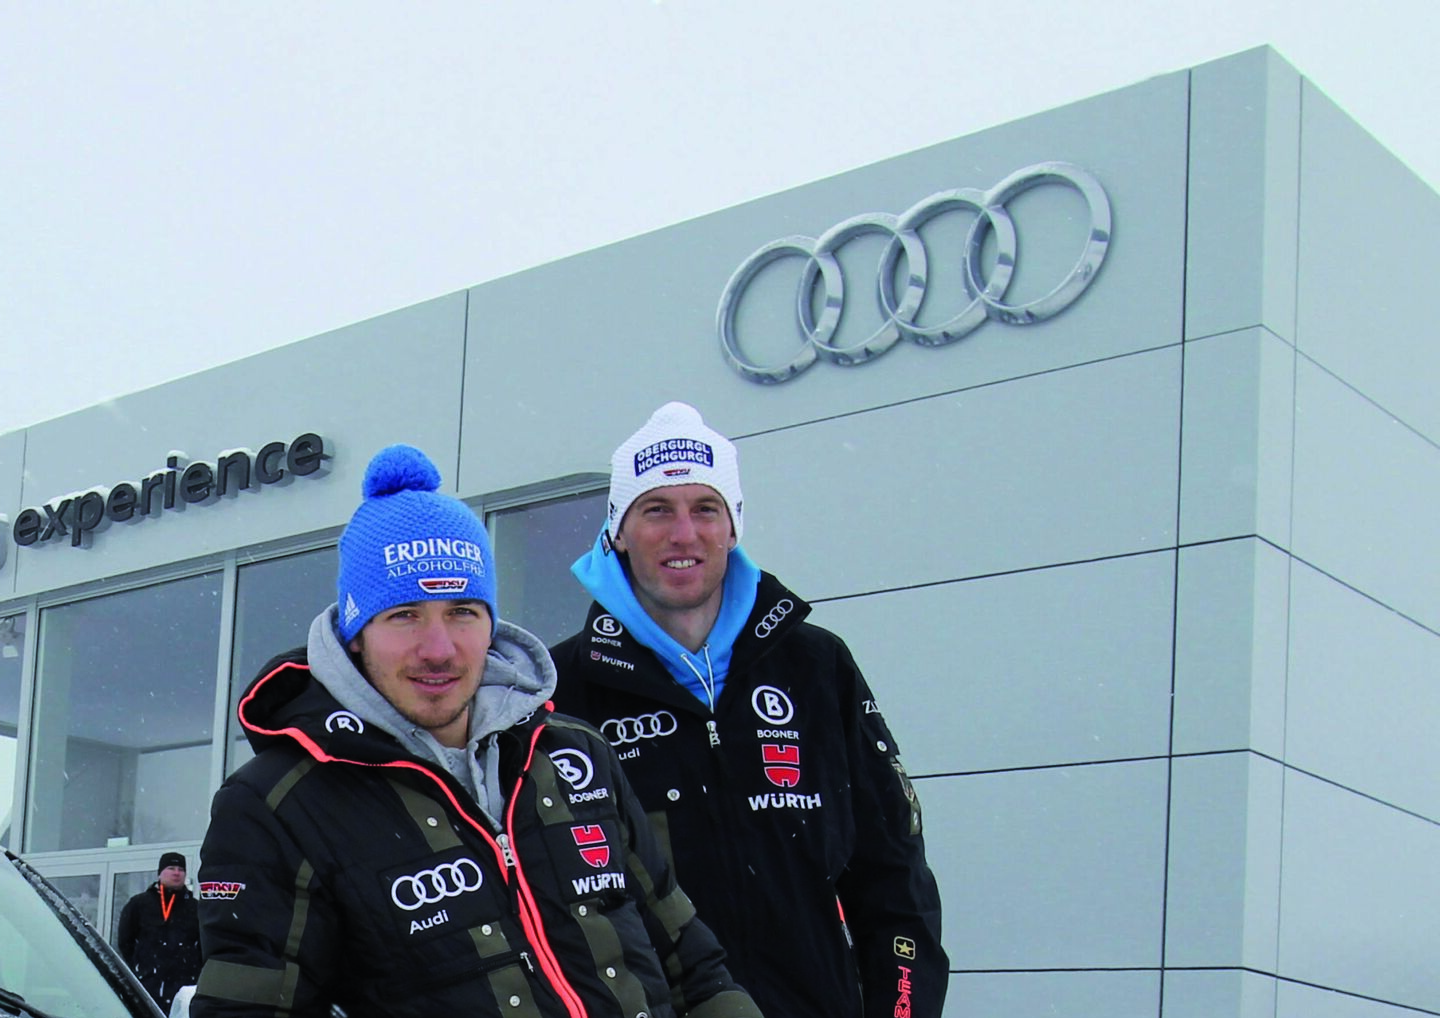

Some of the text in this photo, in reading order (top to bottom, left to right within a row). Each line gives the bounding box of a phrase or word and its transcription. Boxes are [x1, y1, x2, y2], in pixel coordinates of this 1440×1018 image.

[637, 440, 710, 461] OBERGURGL
[638, 451, 711, 473] HOCHGURGL
[13, 432, 325, 547] experience
[383, 538, 484, 566] ERDINGER
[591, 636, 622, 647] BOGNER
[757, 729, 799, 740] BOGNER
[618, 747, 641, 761] udi
[569, 787, 609, 804] BOGNER
[748, 793, 822, 812] WÜRTH
[572, 872, 626, 896] WÜRTH
[409, 909, 449, 935] Audi
